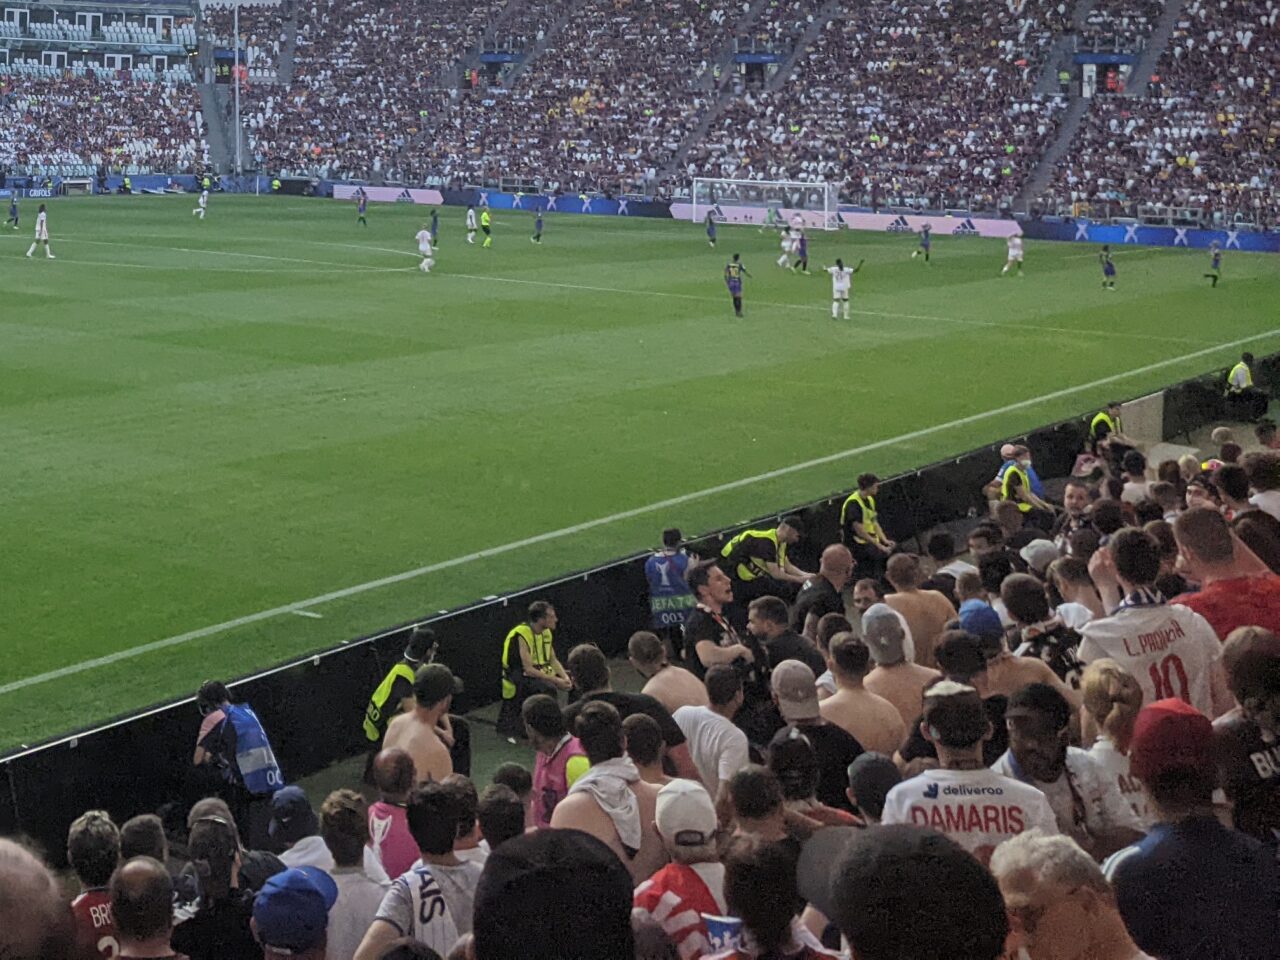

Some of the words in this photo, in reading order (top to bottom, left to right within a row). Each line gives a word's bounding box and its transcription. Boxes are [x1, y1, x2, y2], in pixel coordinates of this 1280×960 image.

[29, 189, 51, 197] GRIFOLS
[662, 612, 685, 624] 003
[1149, 653, 1192, 706] 10
[942, 785, 1004, 796] deliveroo
[911, 803, 1025, 836] DAMARIS
